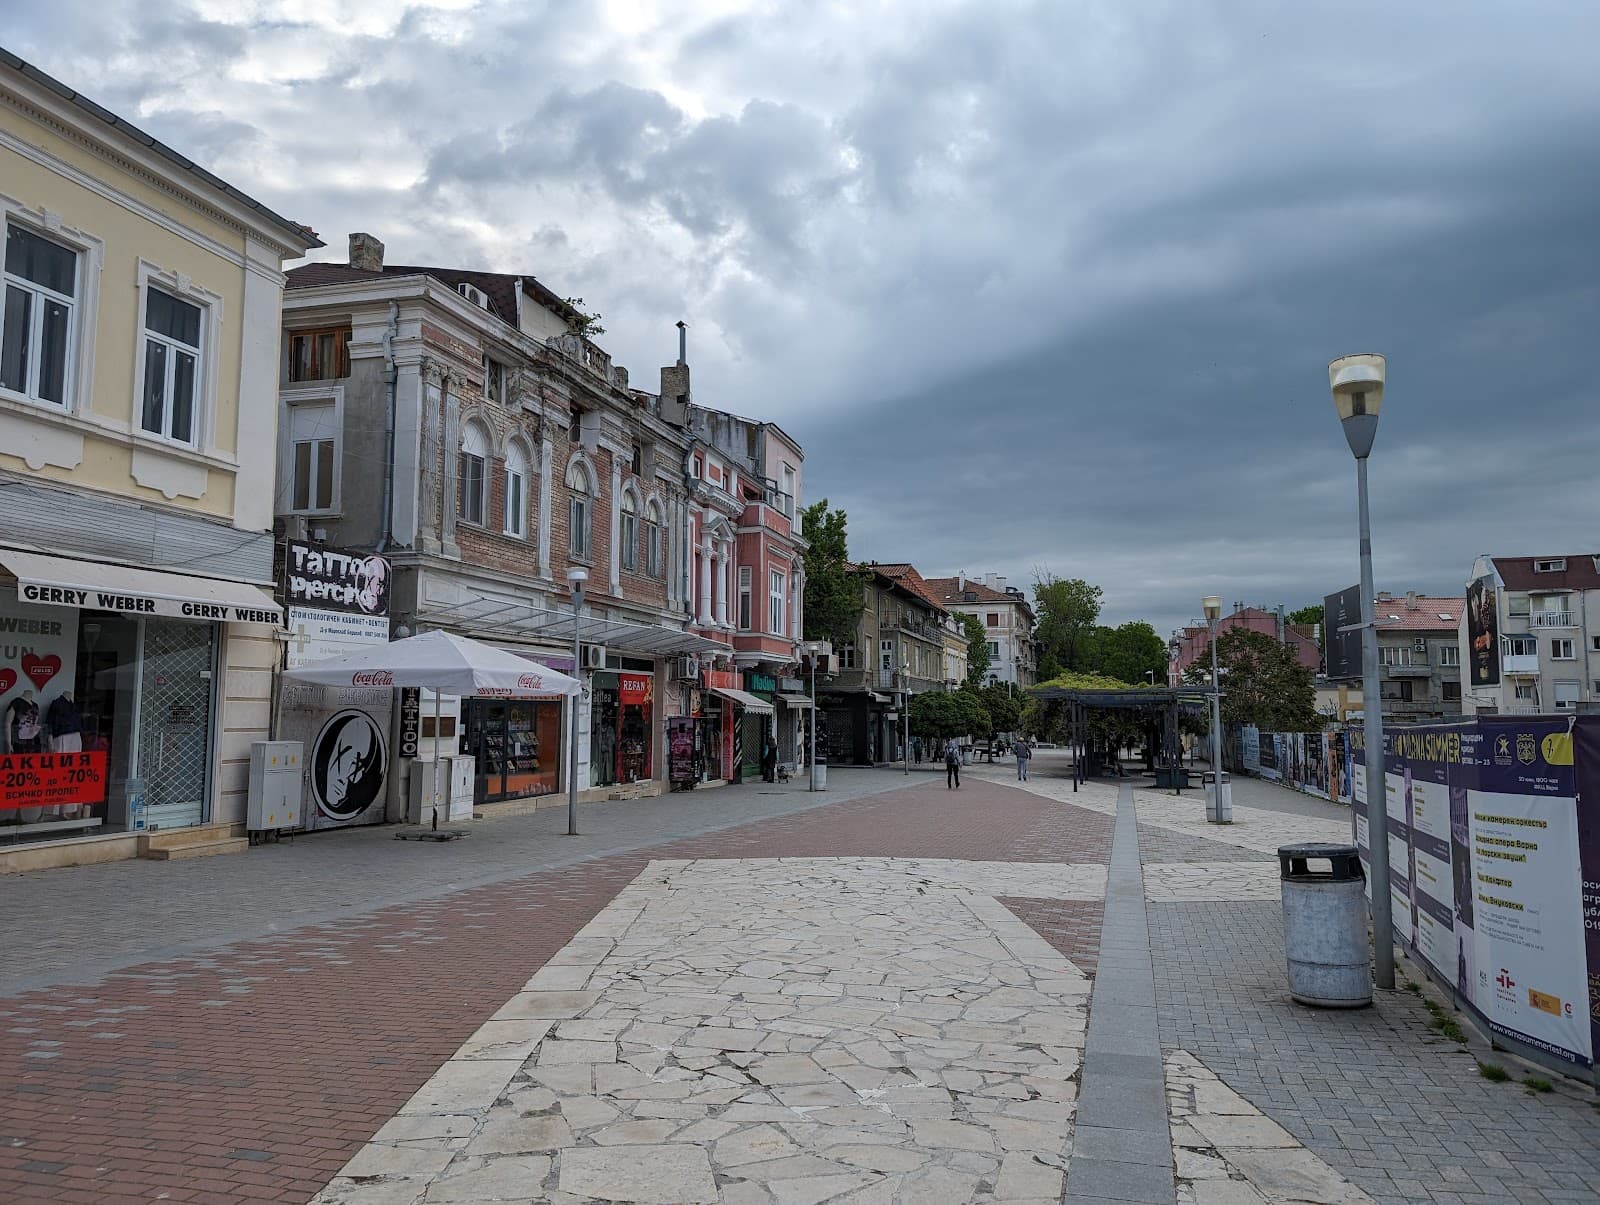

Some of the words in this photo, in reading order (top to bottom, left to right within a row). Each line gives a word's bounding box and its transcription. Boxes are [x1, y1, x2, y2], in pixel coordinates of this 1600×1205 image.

[24, 585, 87, 605] GERRY
[98, 593, 155, 612] WEBER
[182, 602, 229, 618] GERRY
[236, 608, 280, 624] WEBER
[0, 617, 62, 636] WEBER
[0, 645, 34, 660] UN
[353, 670, 393, 686] Coca-Cola
[518, 672, 543, 689] Coca-Cola
[402, 687, 419, 755] TATTOO
[1, 754, 91, 770] АКЦИЯ
[1, 772, 41, 788] -20%
